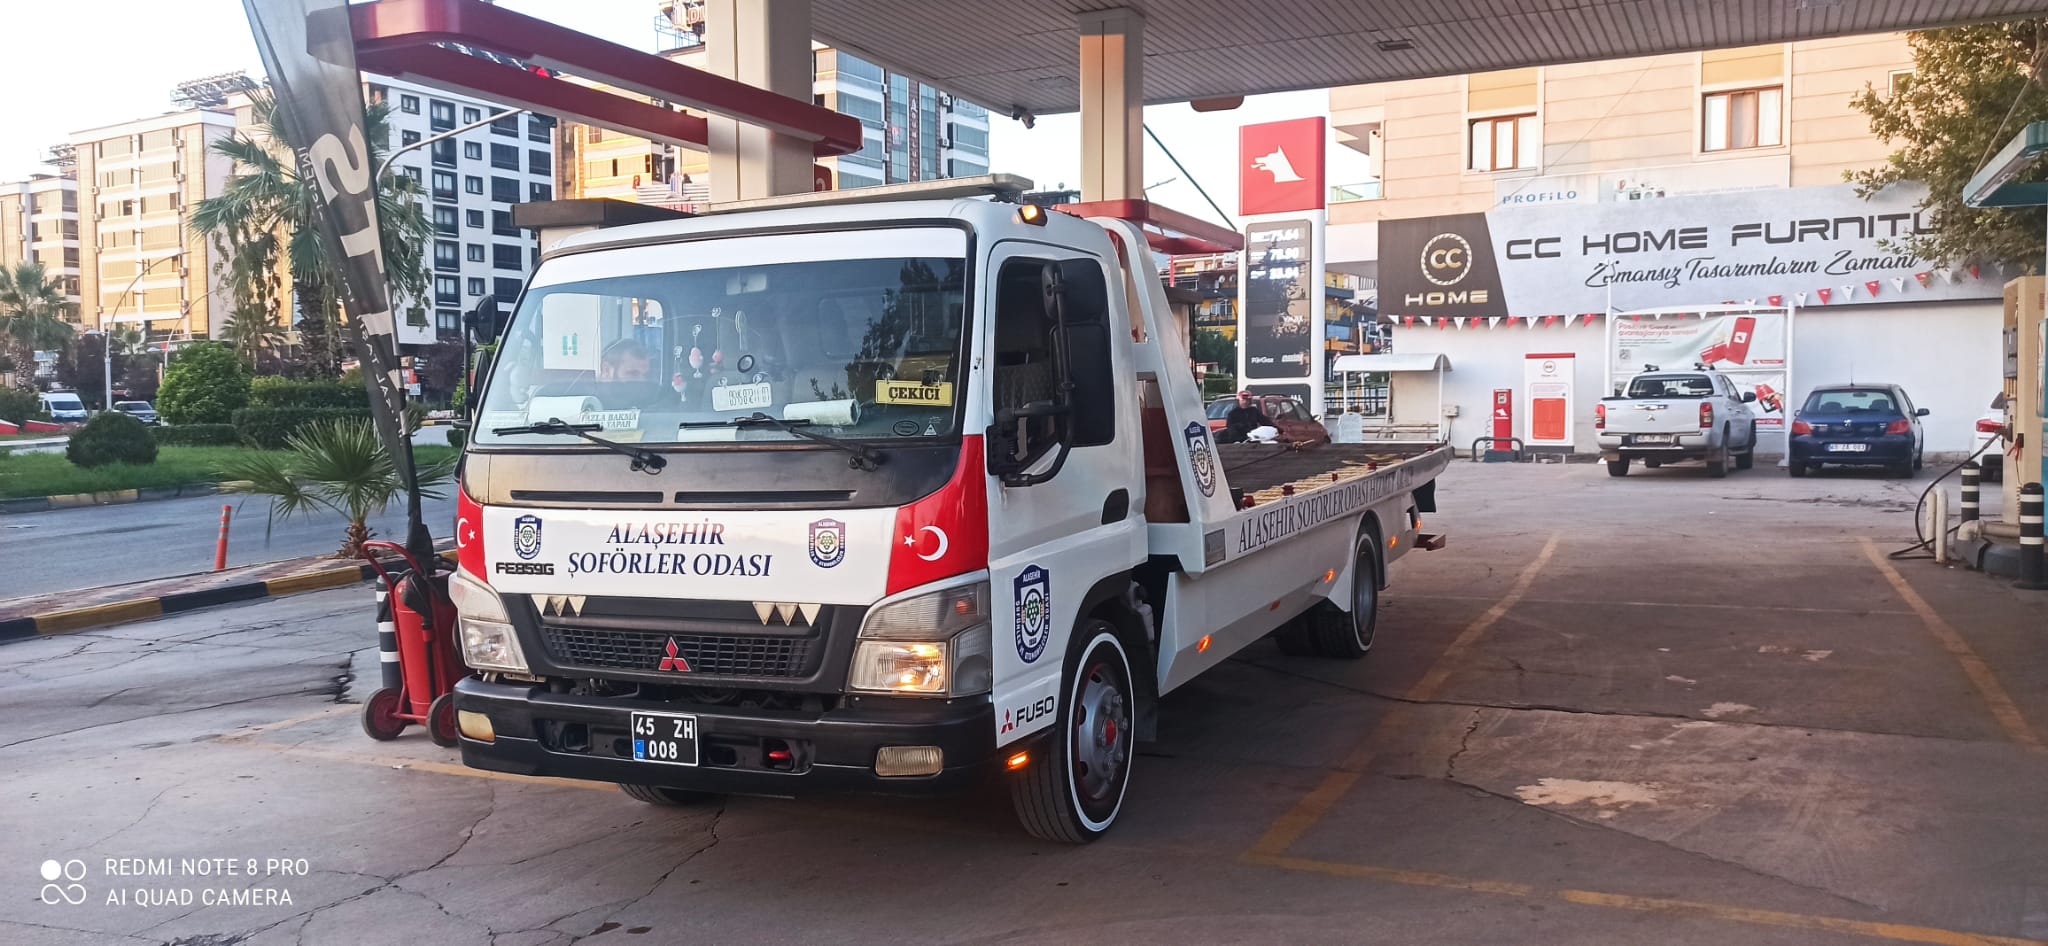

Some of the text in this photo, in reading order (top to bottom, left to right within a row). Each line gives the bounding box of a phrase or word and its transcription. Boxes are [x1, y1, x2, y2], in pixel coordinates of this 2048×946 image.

[1506, 236, 1562, 260] CC
[1582, 225, 1707, 255] HOME
[1430, 249, 1462, 269] CC
[1405, 290, 1488, 307] HOME
[1238, 499, 1295, 554] ALAŞEHİR
[1297, 489, 1344, 531] ŞOFÖRLER
[1344, 480, 1369, 512] ODASI
[607, 516, 725, 550] ALAŞEHİR
[567, 548, 773, 579] ŞOFÖRLER ODASI
[1016, 696, 1055, 727] FUSO
[635, 717, 694, 739] 45 ZH
[648, 740, 678, 759] 008
